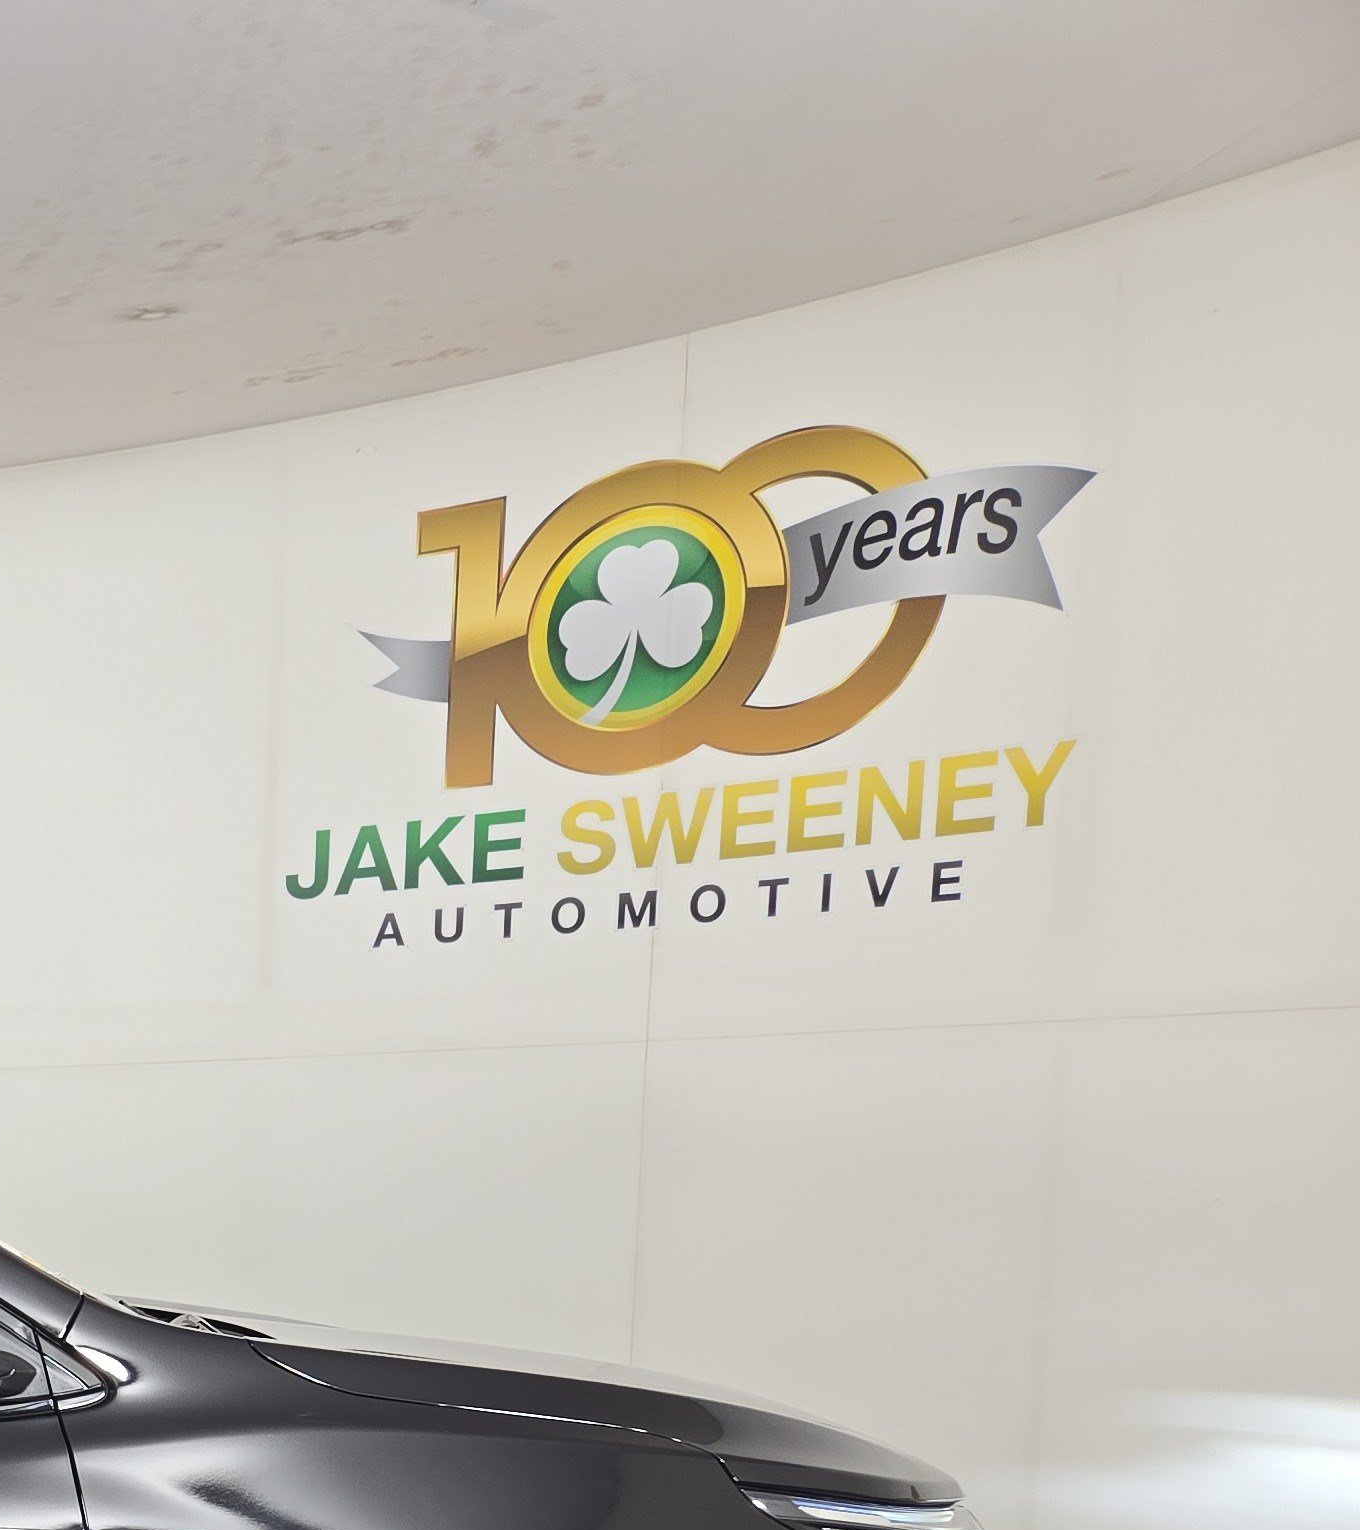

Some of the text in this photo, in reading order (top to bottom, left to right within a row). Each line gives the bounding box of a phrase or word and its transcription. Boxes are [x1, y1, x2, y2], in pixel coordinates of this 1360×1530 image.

[417, 425, 1023, 789] 100 years
[284, 739, 1077, 902] JAKE SWEENEY
[372, 860, 965, 950] AUTOMOTIVE
